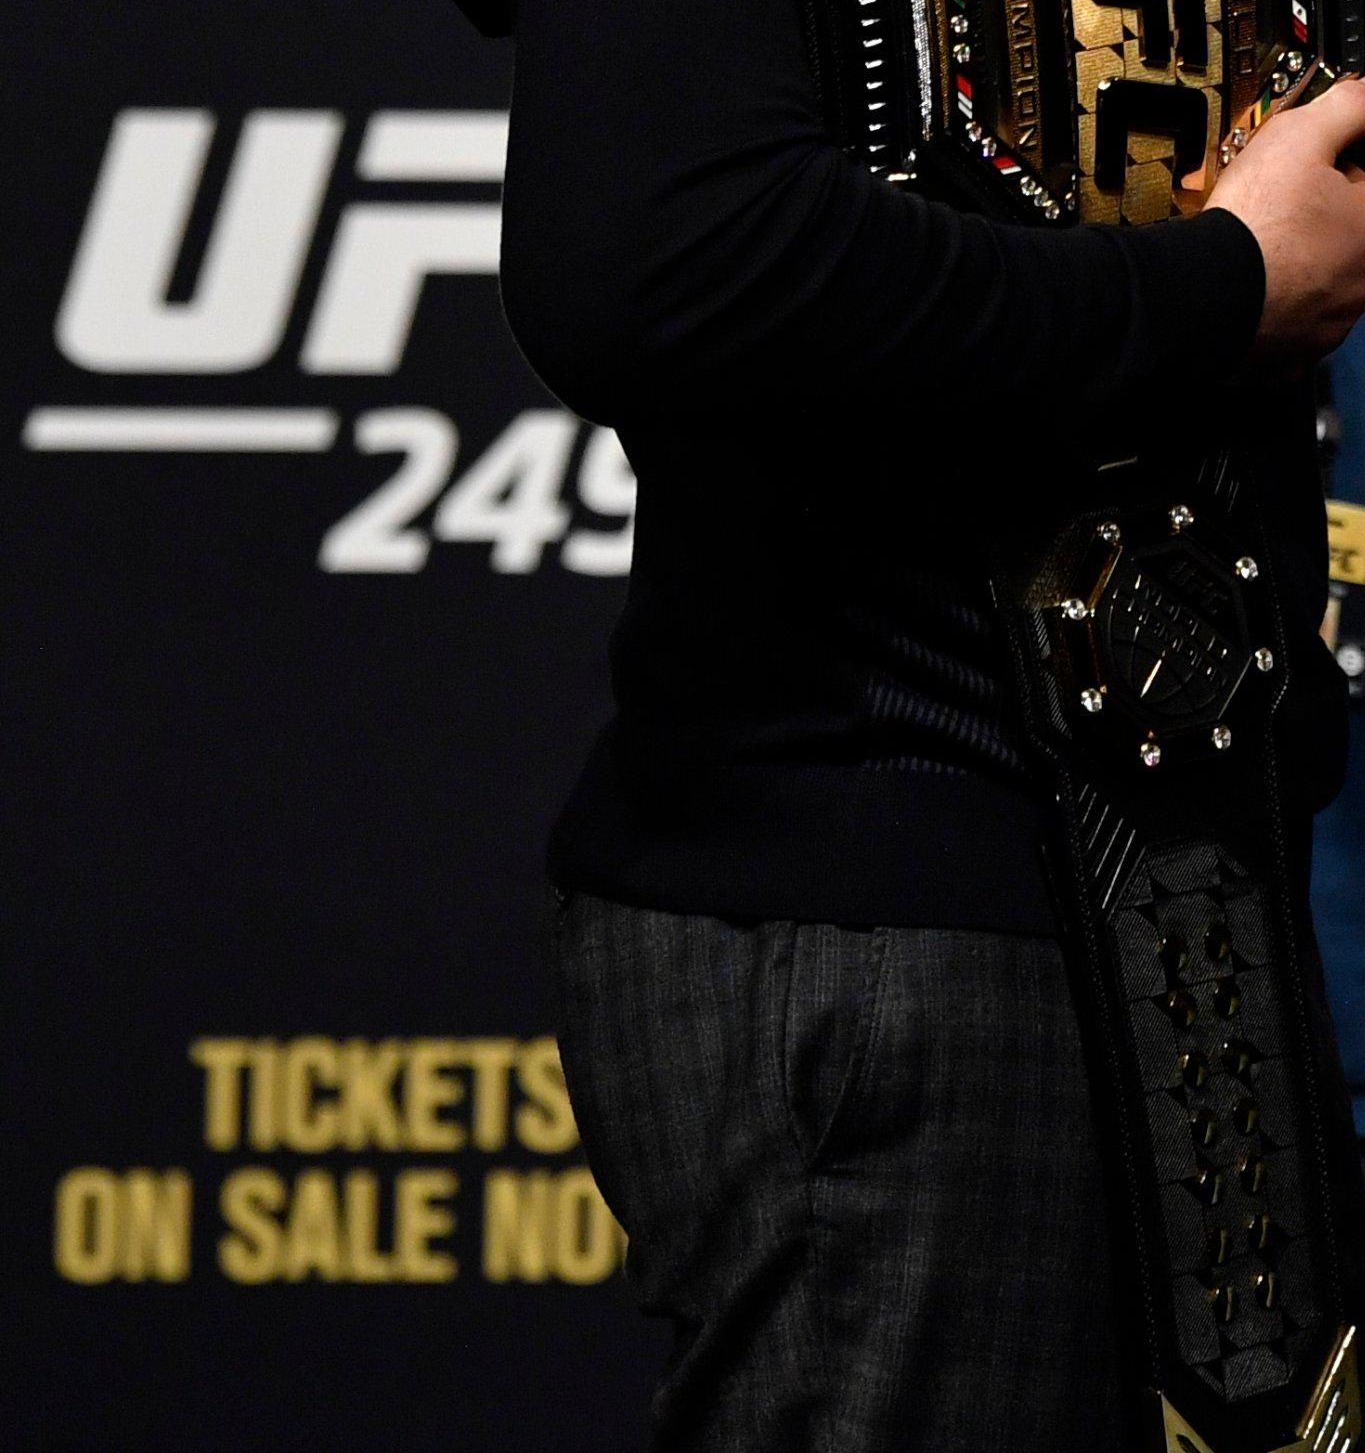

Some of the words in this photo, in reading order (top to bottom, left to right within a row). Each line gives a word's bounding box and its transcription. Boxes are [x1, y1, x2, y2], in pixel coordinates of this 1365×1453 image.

[190, 1036, 582, 1154] TICKETS
[54, 1166, 194, 1286] ON
[217, 1166, 458, 1286] SALE
[482, 1166, 629, 1287] NO
